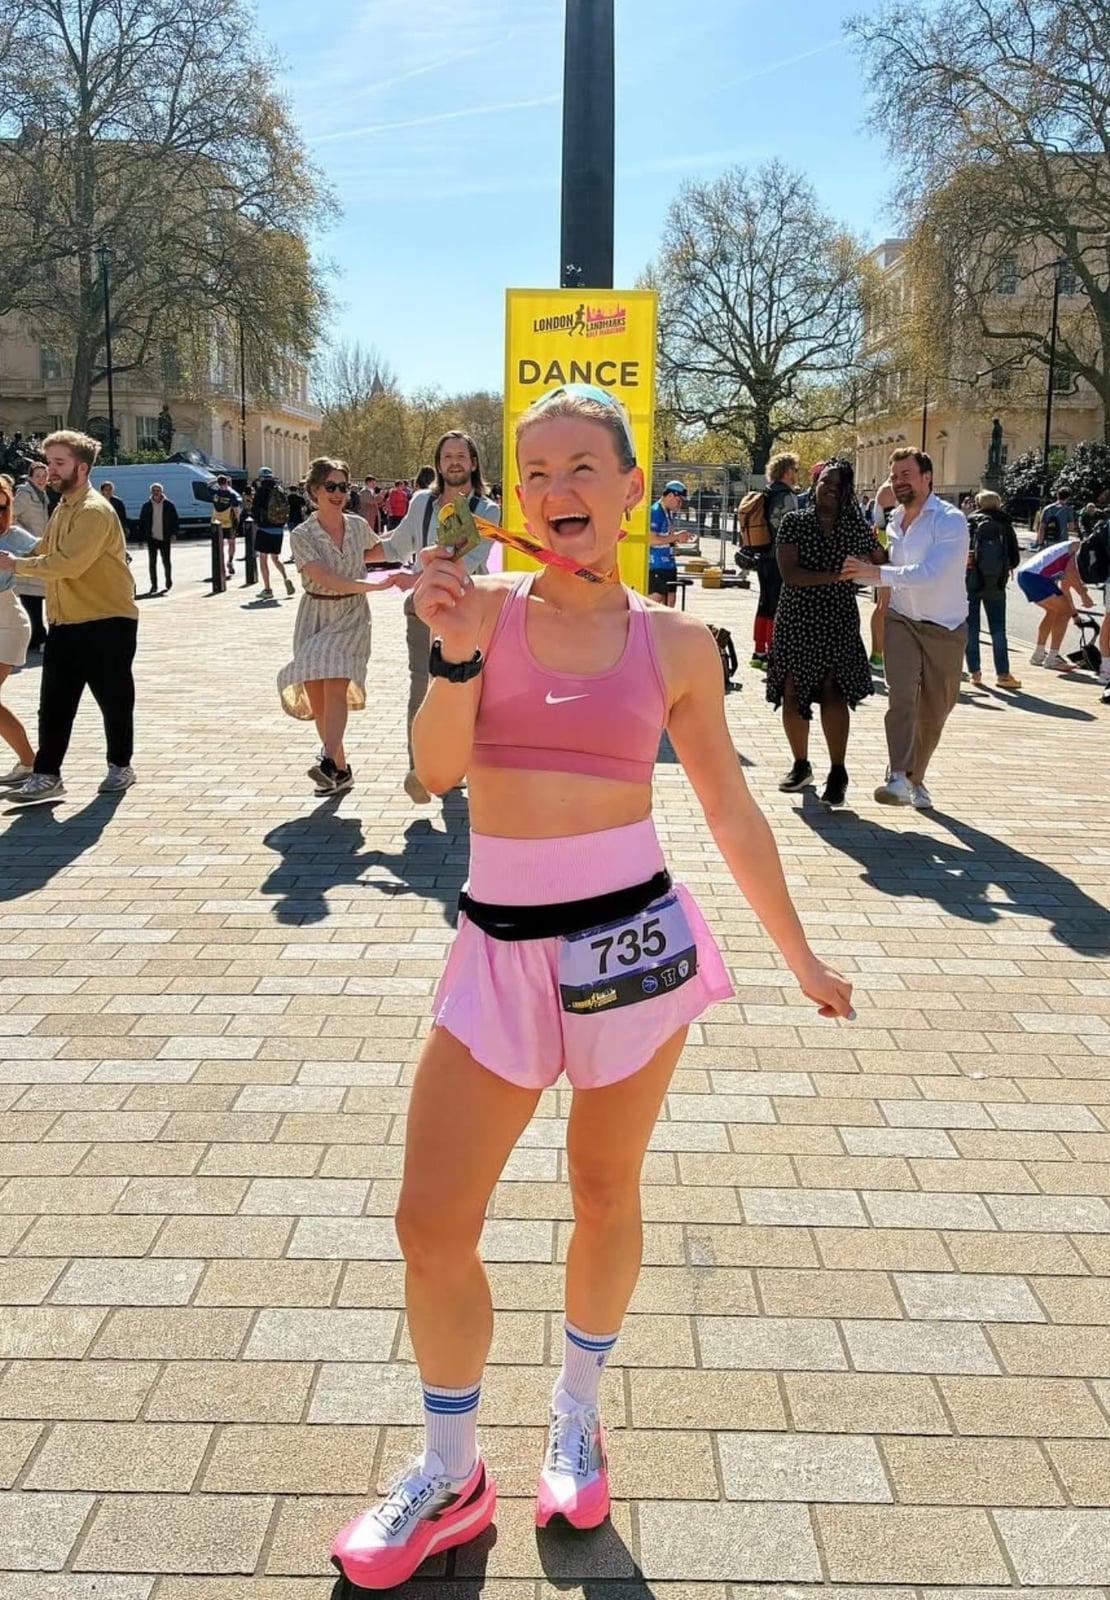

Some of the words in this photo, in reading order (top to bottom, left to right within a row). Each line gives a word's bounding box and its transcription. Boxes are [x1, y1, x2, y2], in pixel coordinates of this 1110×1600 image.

[534, 314, 574, 332] LONDON
[586, 318, 626, 331] LANDMARKS
[519, 360, 639, 386] DANCE
[591, 918, 666, 974] 735
